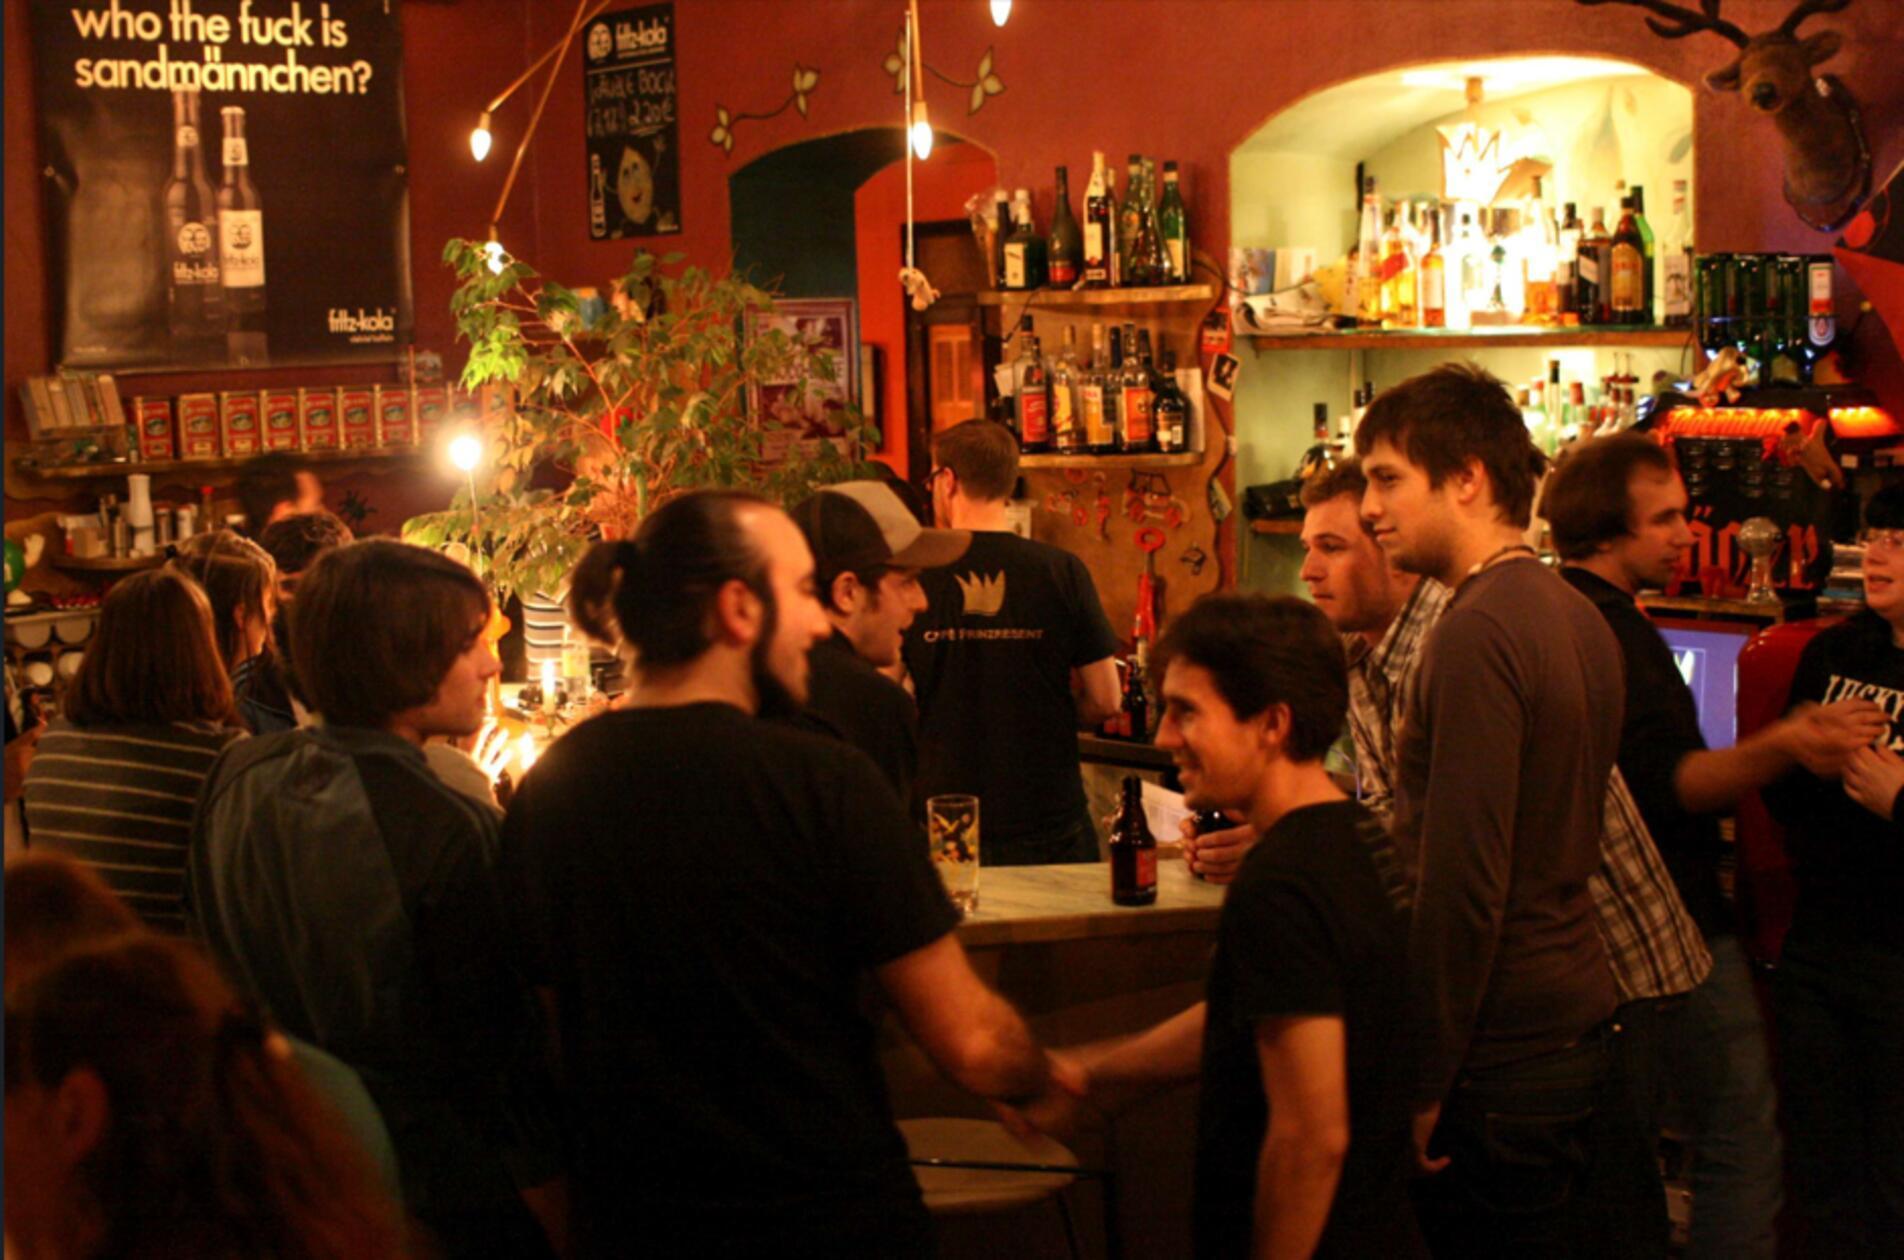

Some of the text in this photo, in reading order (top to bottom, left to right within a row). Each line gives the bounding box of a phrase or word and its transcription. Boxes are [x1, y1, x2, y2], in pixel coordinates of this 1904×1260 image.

[72, 0, 348, 48] who the fuck is
[75, 44, 373, 94] sandmännchen?
[328, 307, 394, 334] fritz-kola
